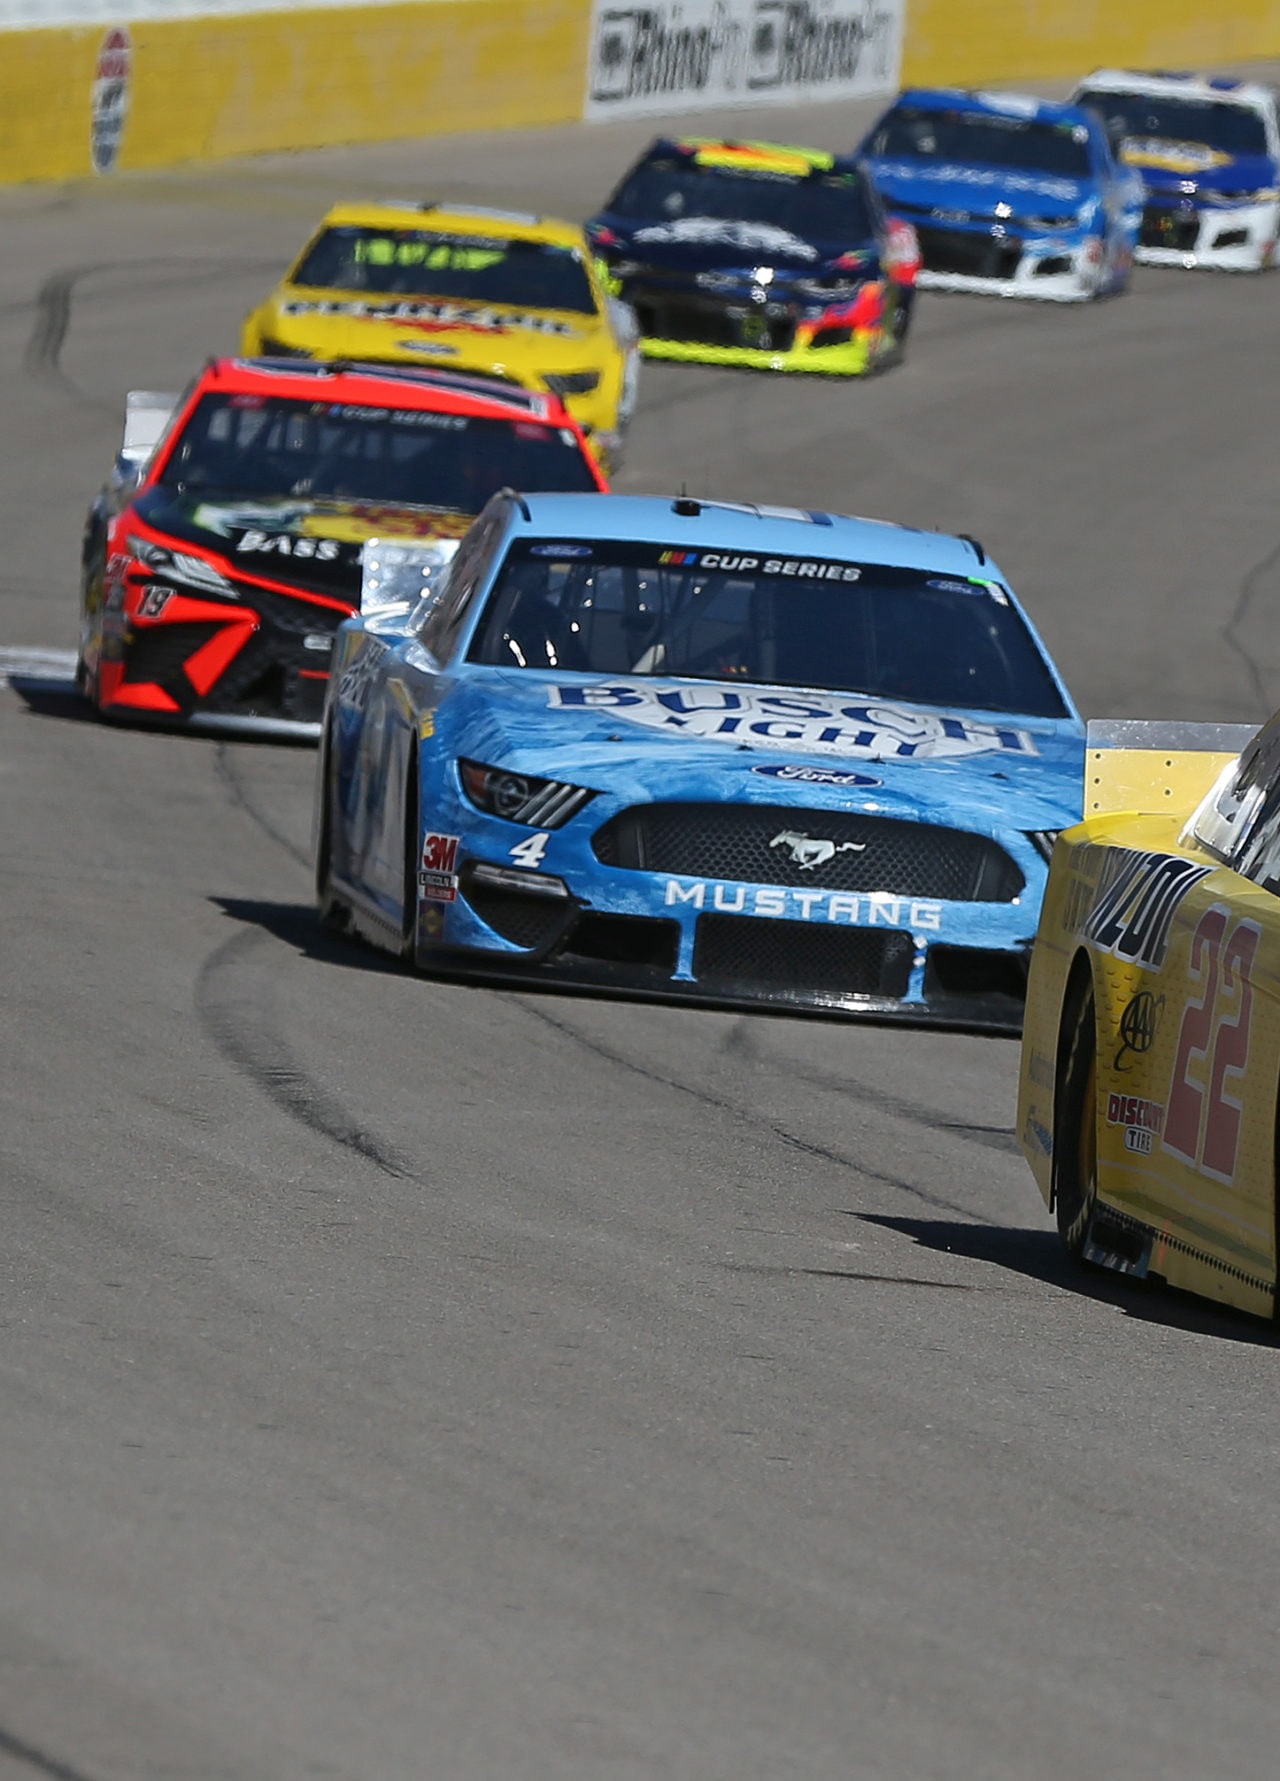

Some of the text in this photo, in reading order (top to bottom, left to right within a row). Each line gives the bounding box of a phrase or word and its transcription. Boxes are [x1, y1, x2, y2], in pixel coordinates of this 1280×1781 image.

[237, 530, 331, 561] BASS
[701, 553, 862, 582] CUP SERIES
[136, 586, 175, 620] 19
[549, 684, 1040, 756] BUSCH
[776, 764, 857, 785] Ford
[423, 835, 458, 872] 3M
[508, 832, 551, 868] 4
[664, 880, 943, 930] MUSTANG
[1162, 902, 1263, 1186] 22
